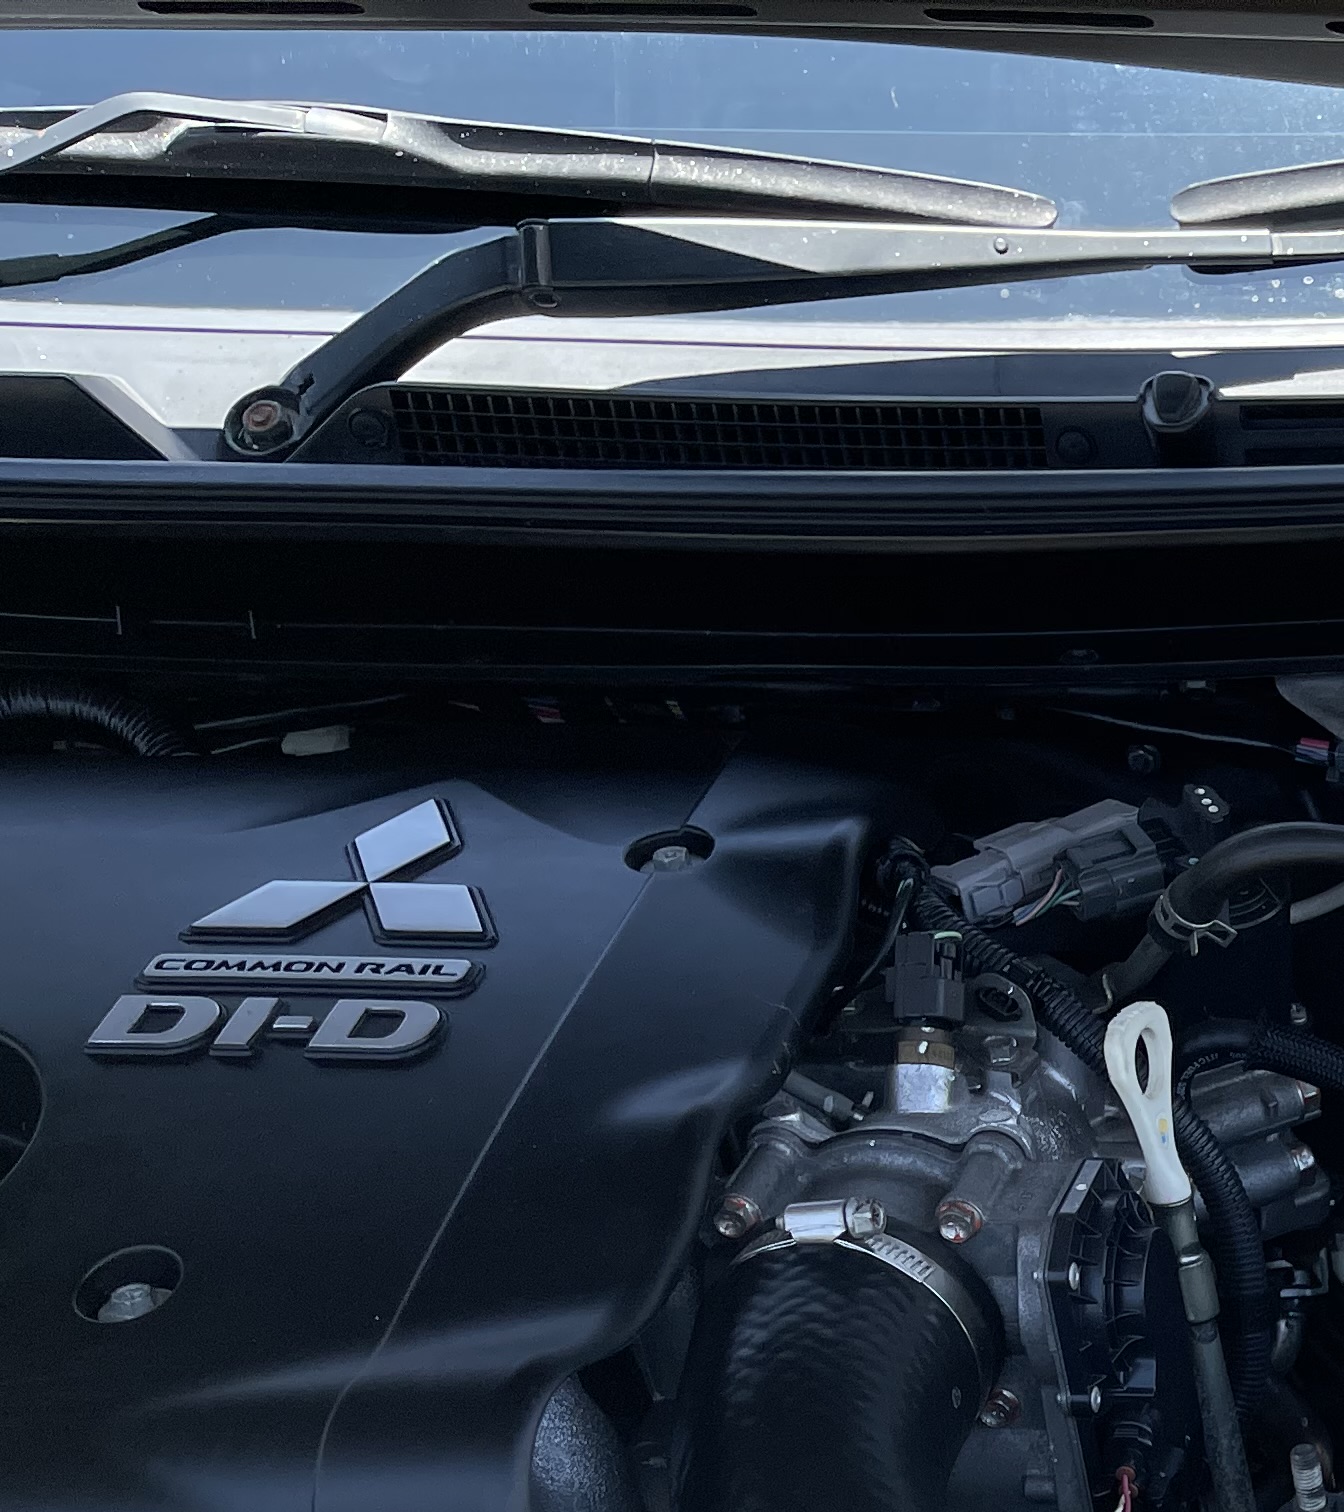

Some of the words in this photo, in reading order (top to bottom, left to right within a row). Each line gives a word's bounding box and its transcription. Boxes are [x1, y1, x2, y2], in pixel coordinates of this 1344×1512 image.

[152, 956, 346, 977] COMMON
[353, 959, 461, 979] RAIL
[87, 995, 448, 1058] DI-D
